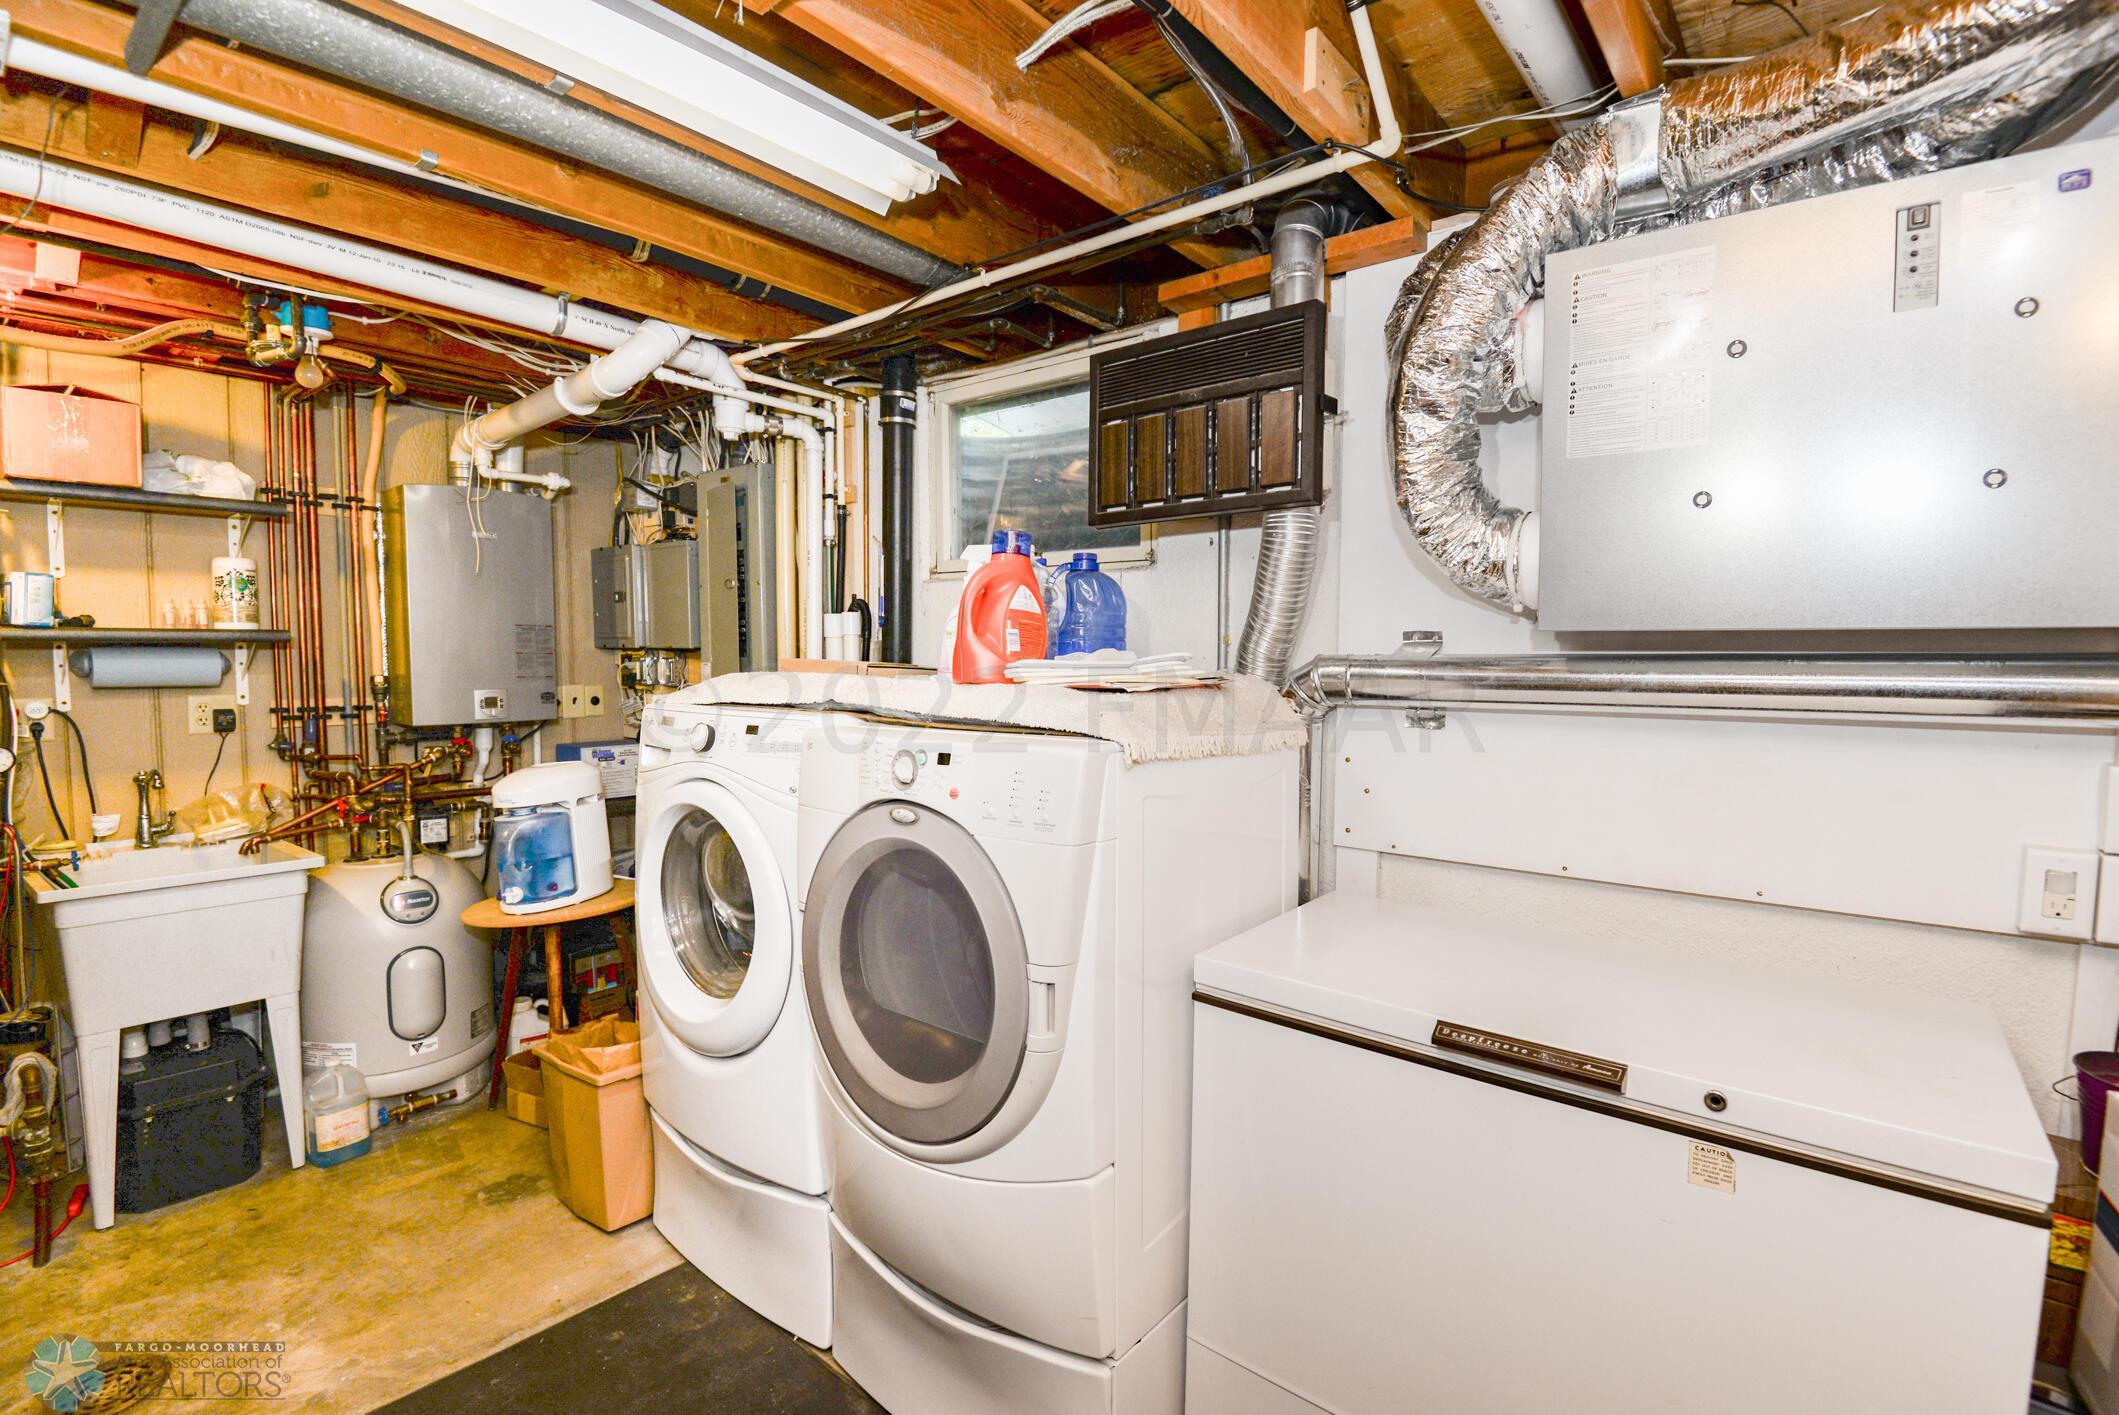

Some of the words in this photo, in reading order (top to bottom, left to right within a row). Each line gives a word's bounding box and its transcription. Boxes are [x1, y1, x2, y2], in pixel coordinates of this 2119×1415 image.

[219, 213, 243, 225] ASTM
[1581, 267, 1612, 279] WARNING
[1580, 292, 1608, 302] CAUTION
[1578, 383, 1613, 393] ATTENTION
[1442, 1027, 1529, 1054] Deepfreeze
[1695, 1145, 1729, 1157] CAUTIO
